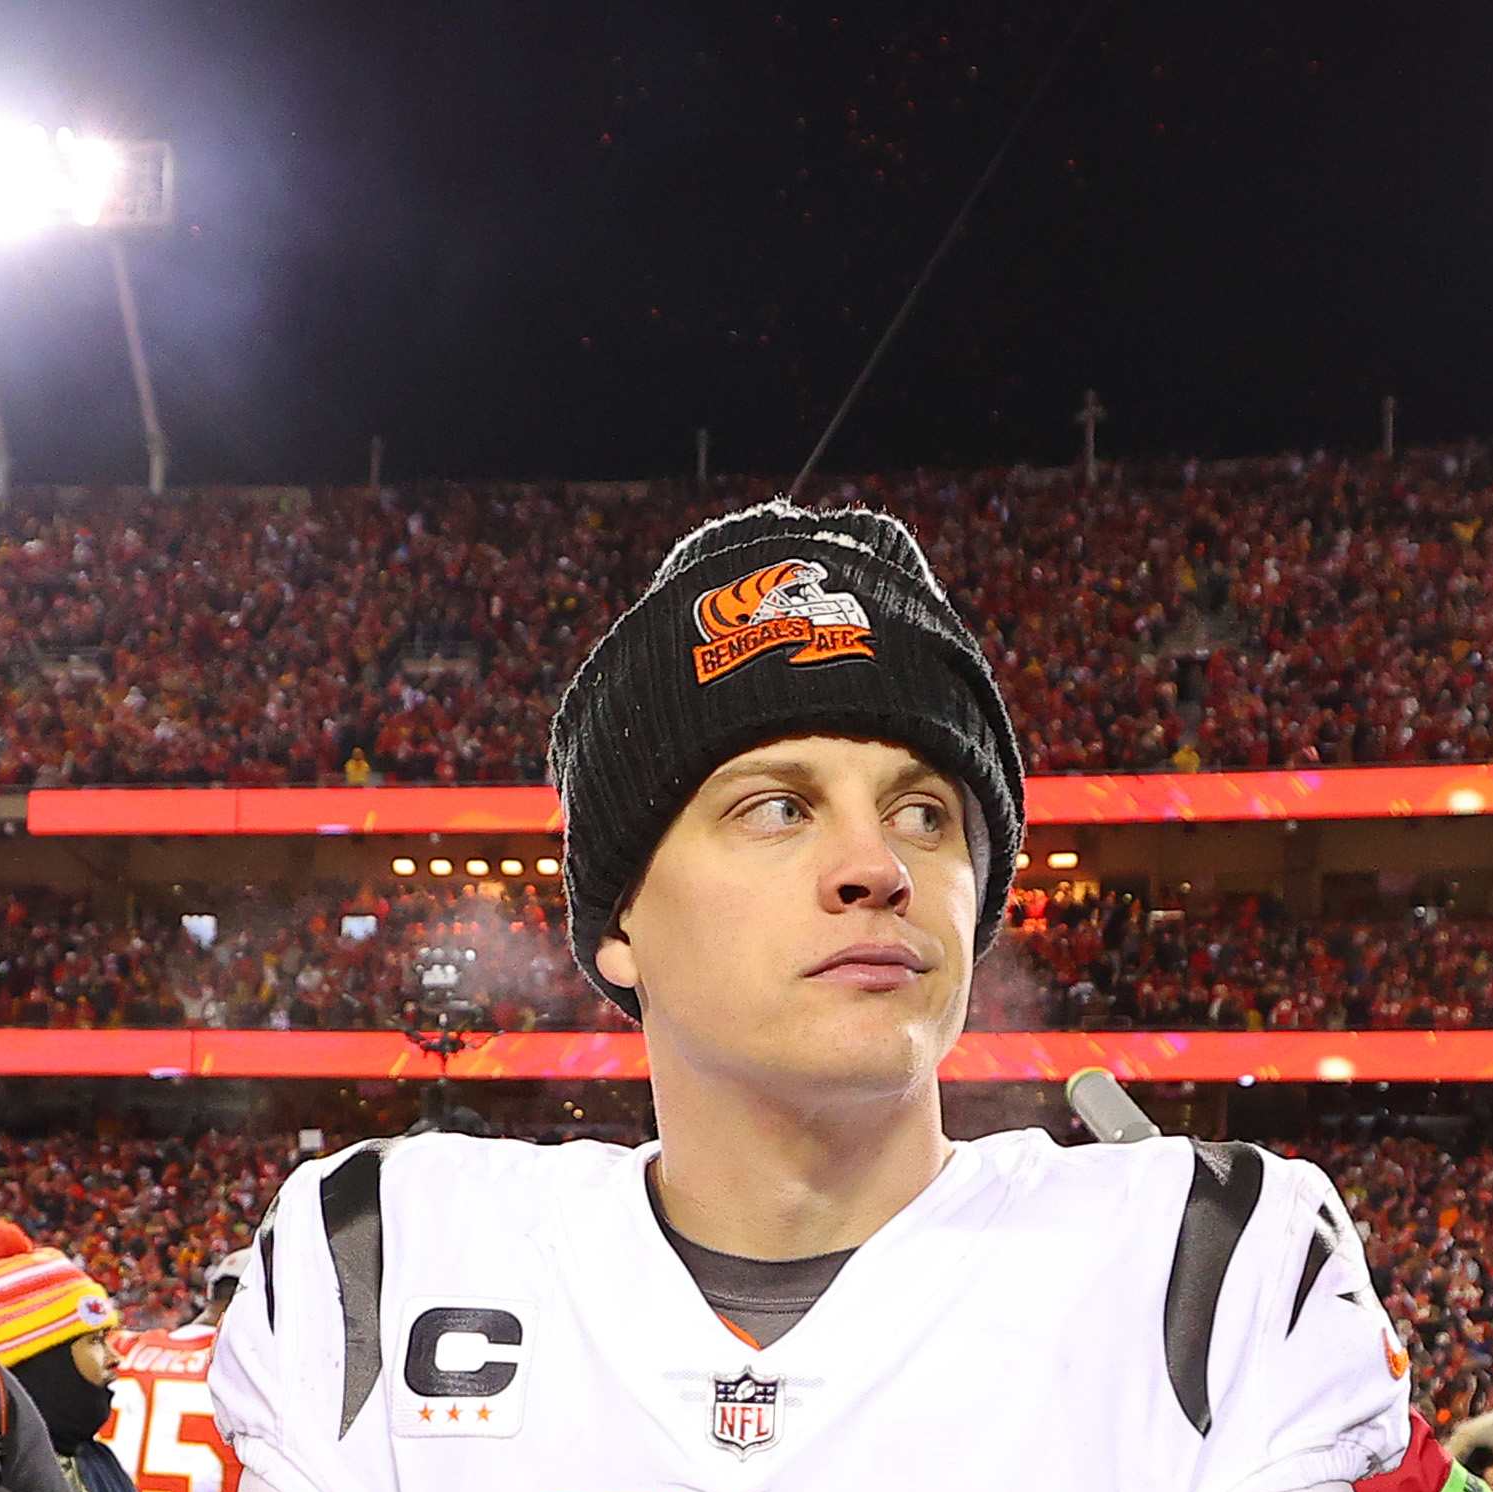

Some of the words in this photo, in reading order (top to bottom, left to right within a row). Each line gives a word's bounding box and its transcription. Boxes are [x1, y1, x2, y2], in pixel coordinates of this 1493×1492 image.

[701, 619, 804, 674] BENGALS
[118, 1345, 207, 1373] JONES
[404, 1306, 523, 1397] C
[718, 1406, 770, 1441] NFL
